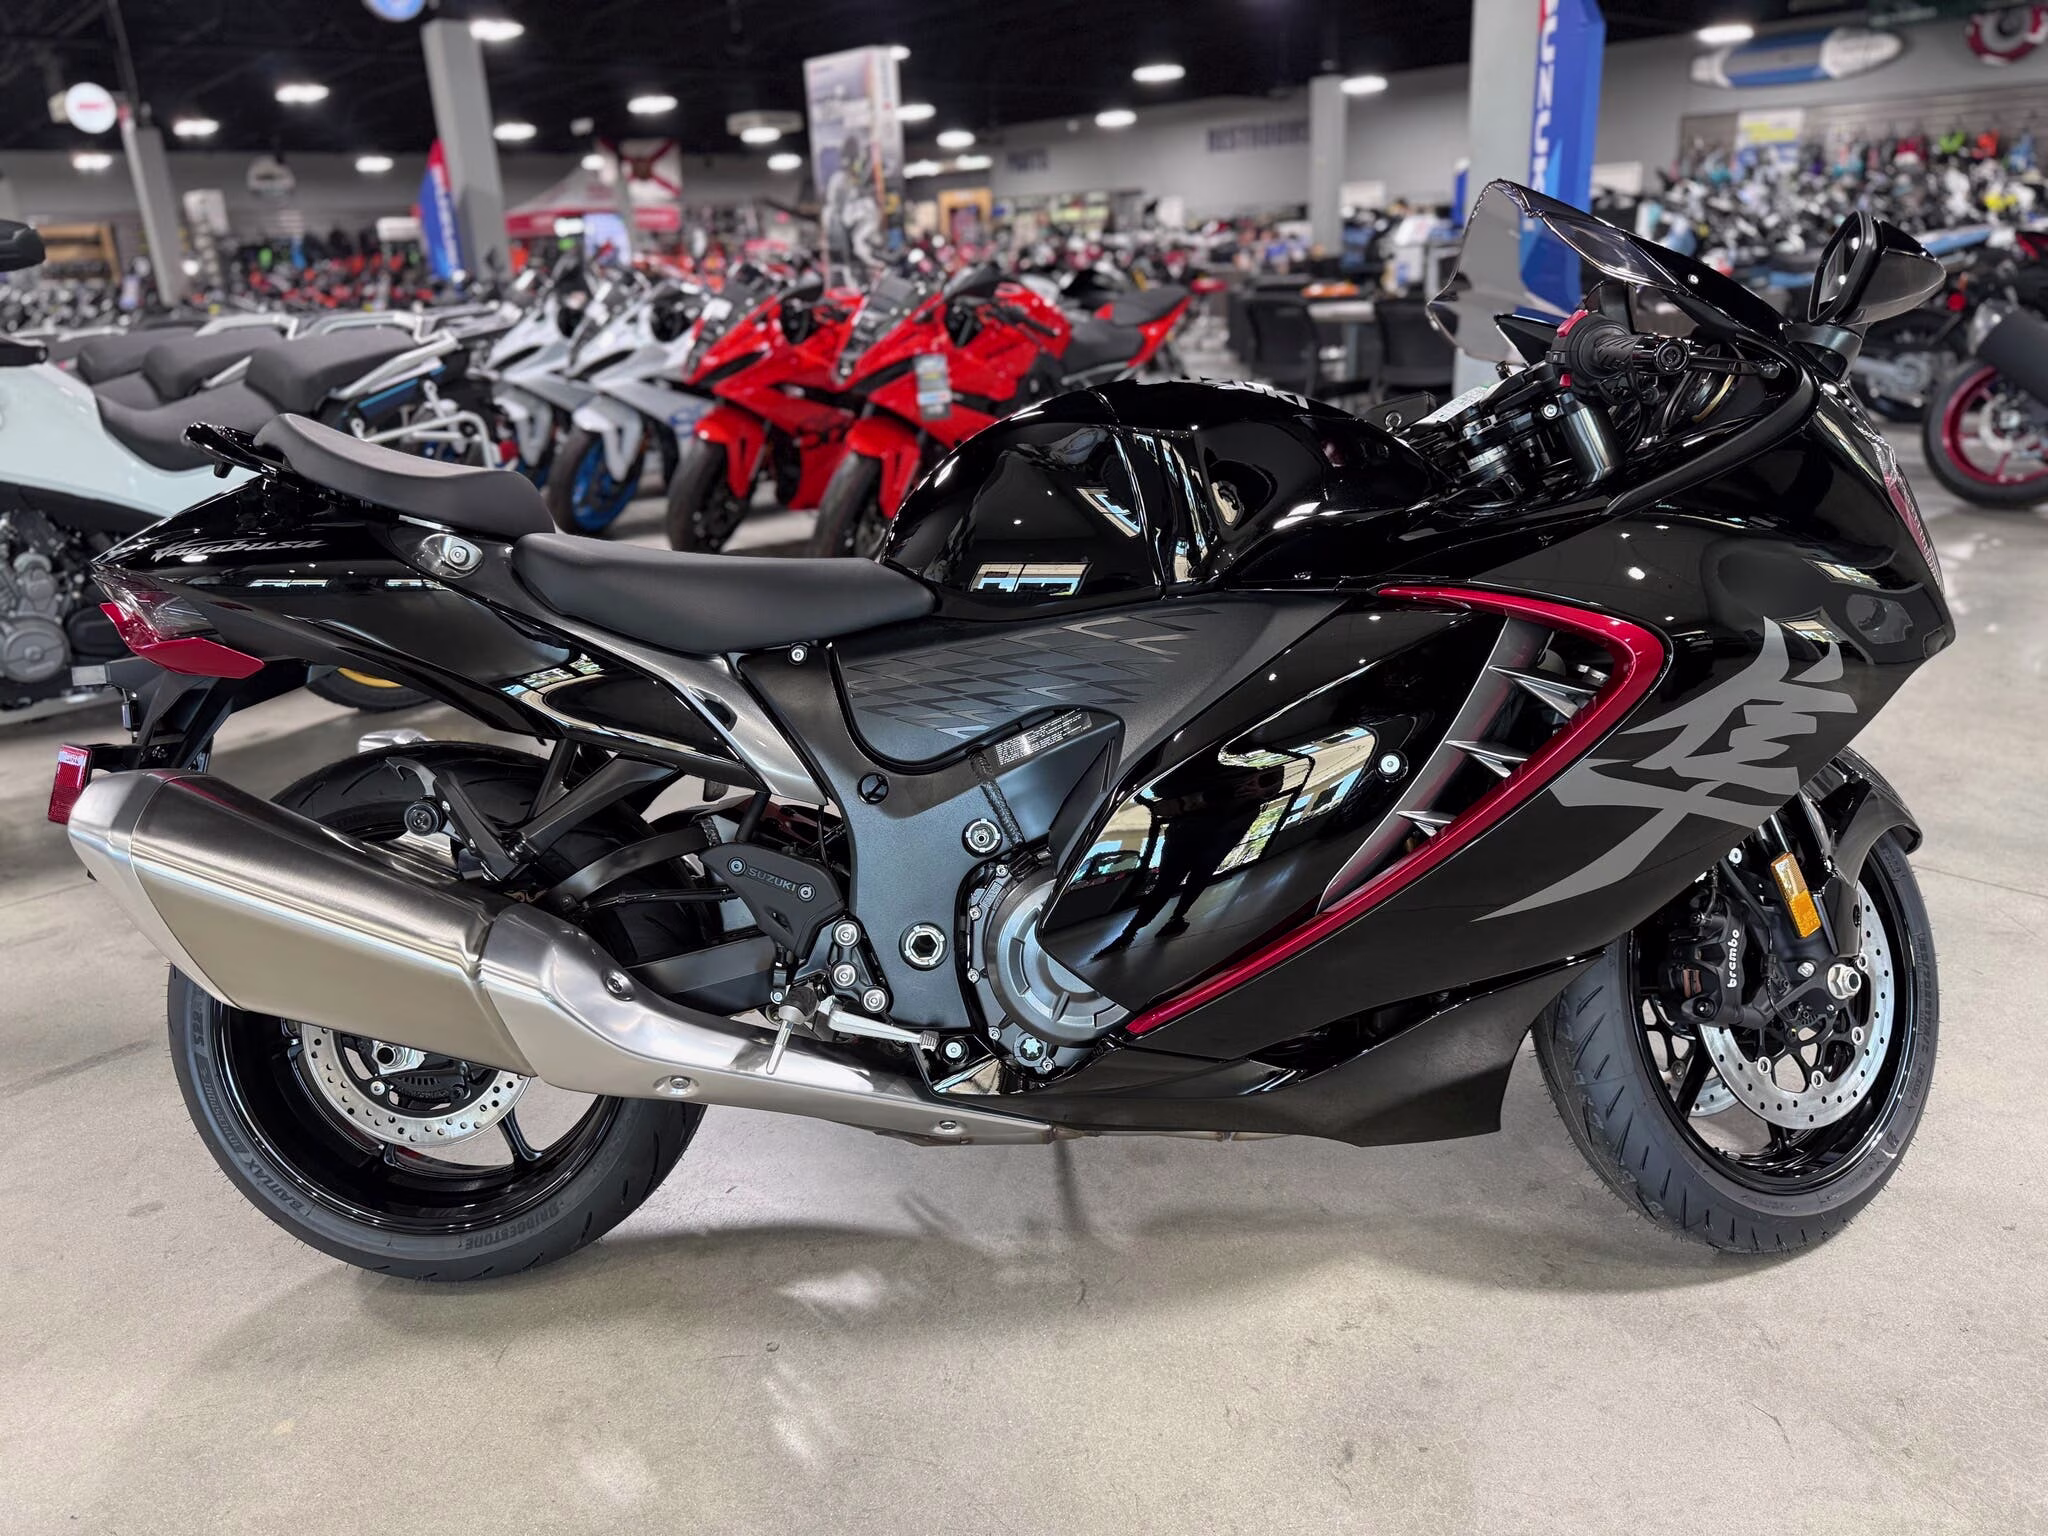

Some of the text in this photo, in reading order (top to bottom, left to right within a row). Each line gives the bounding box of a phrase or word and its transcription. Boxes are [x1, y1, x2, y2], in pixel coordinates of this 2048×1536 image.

[1522, 0, 1561, 233] UZUKI
[150, 537, 330, 562] Hayabusa
[748, 867, 796, 892] SUZUKI
[1727, 929, 1740, 988] brembo
[464, 1202, 561, 1251] BRIDGESTONE
